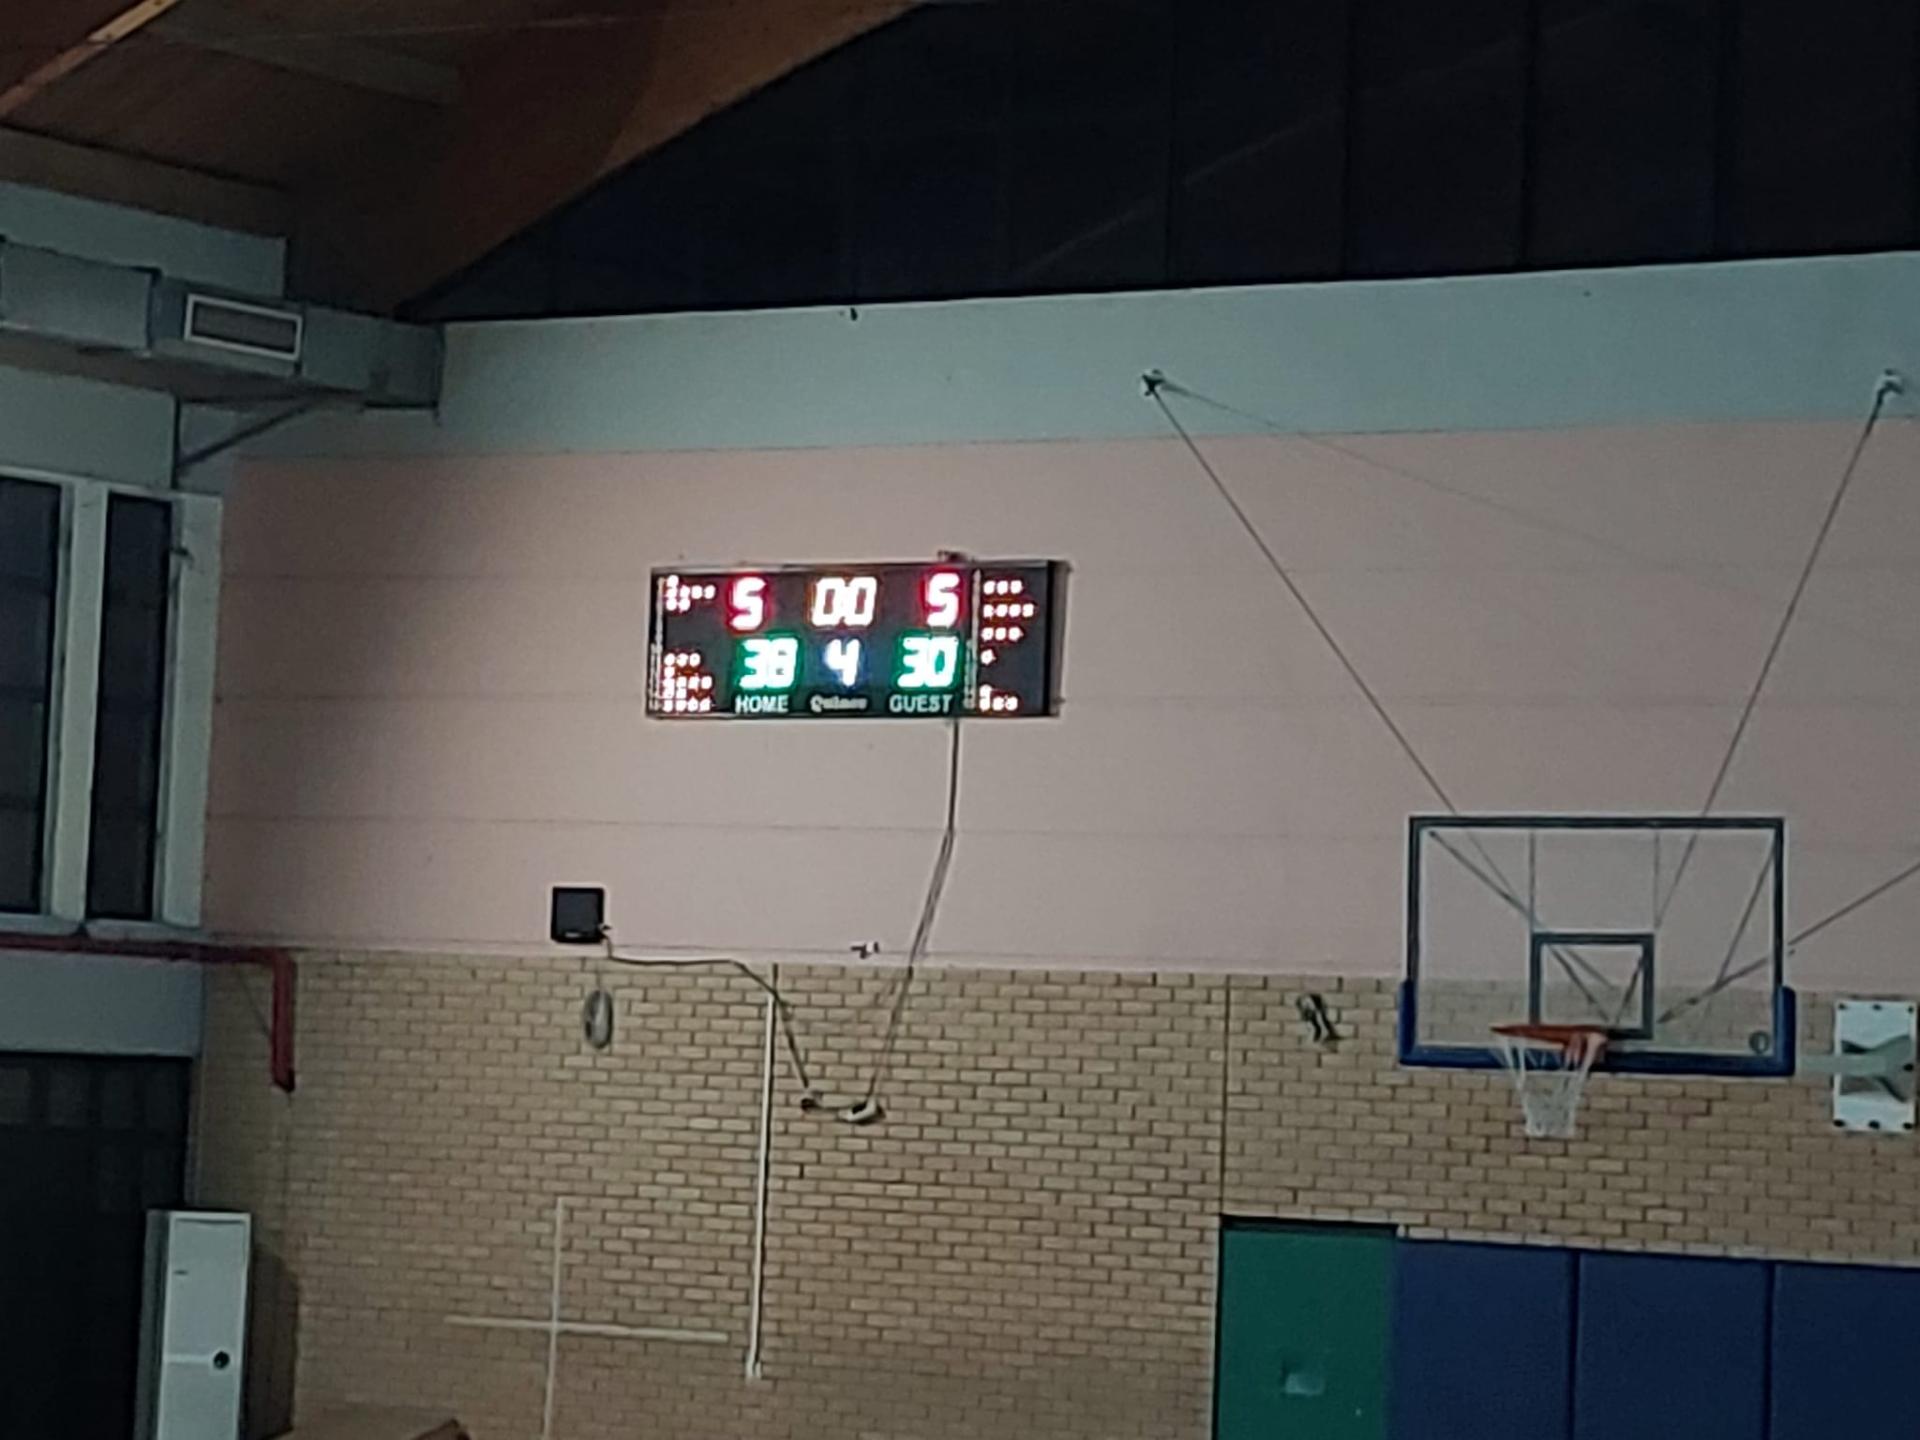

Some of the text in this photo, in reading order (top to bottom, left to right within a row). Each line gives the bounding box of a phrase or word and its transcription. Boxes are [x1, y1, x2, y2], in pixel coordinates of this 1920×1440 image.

[730, 577, 766, 630] 5
[812, 577, 877, 627] 00
[927, 573, 960, 627] 5
[739, 637, 798, 689] 38
[824, 638, 860, 687] 4
[897, 636, 959, 688] 30
[735, 694, 789, 713] HOME
[889, 694, 953, 712] GUEST
